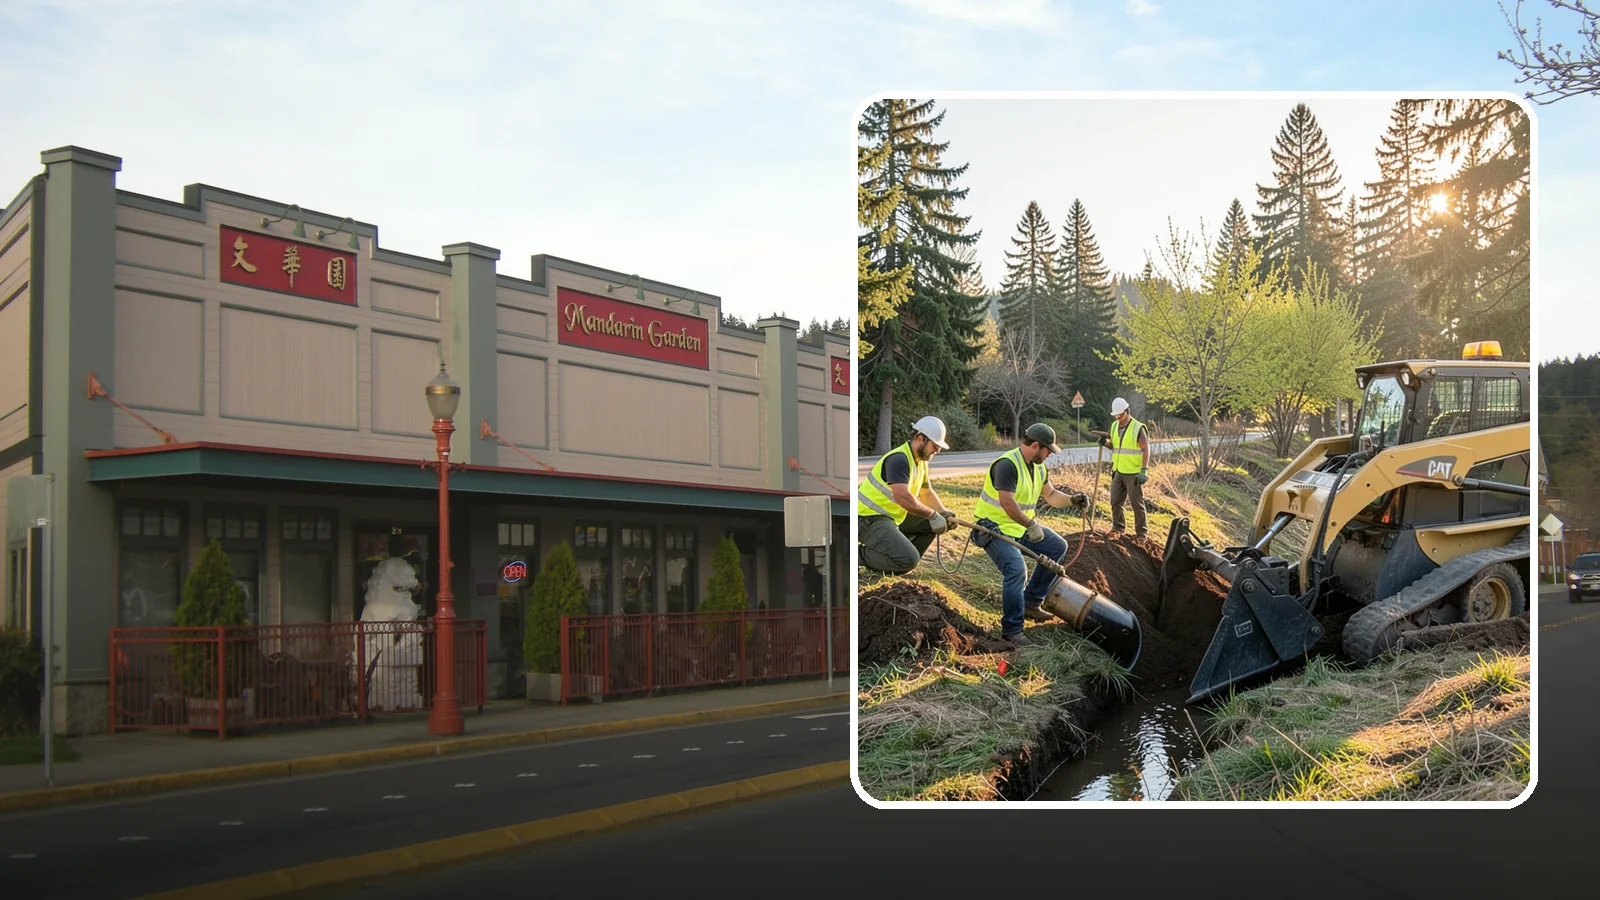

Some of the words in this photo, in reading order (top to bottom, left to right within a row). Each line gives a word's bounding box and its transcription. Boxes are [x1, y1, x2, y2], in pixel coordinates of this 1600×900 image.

[231, 235, 346, 291] 文華園
[564, 302, 644, 341] Mandarin
[653, 320, 702, 352] Garden
[1428, 460, 1452, 480] CAT
[503, 565, 527, 578] OPEN
